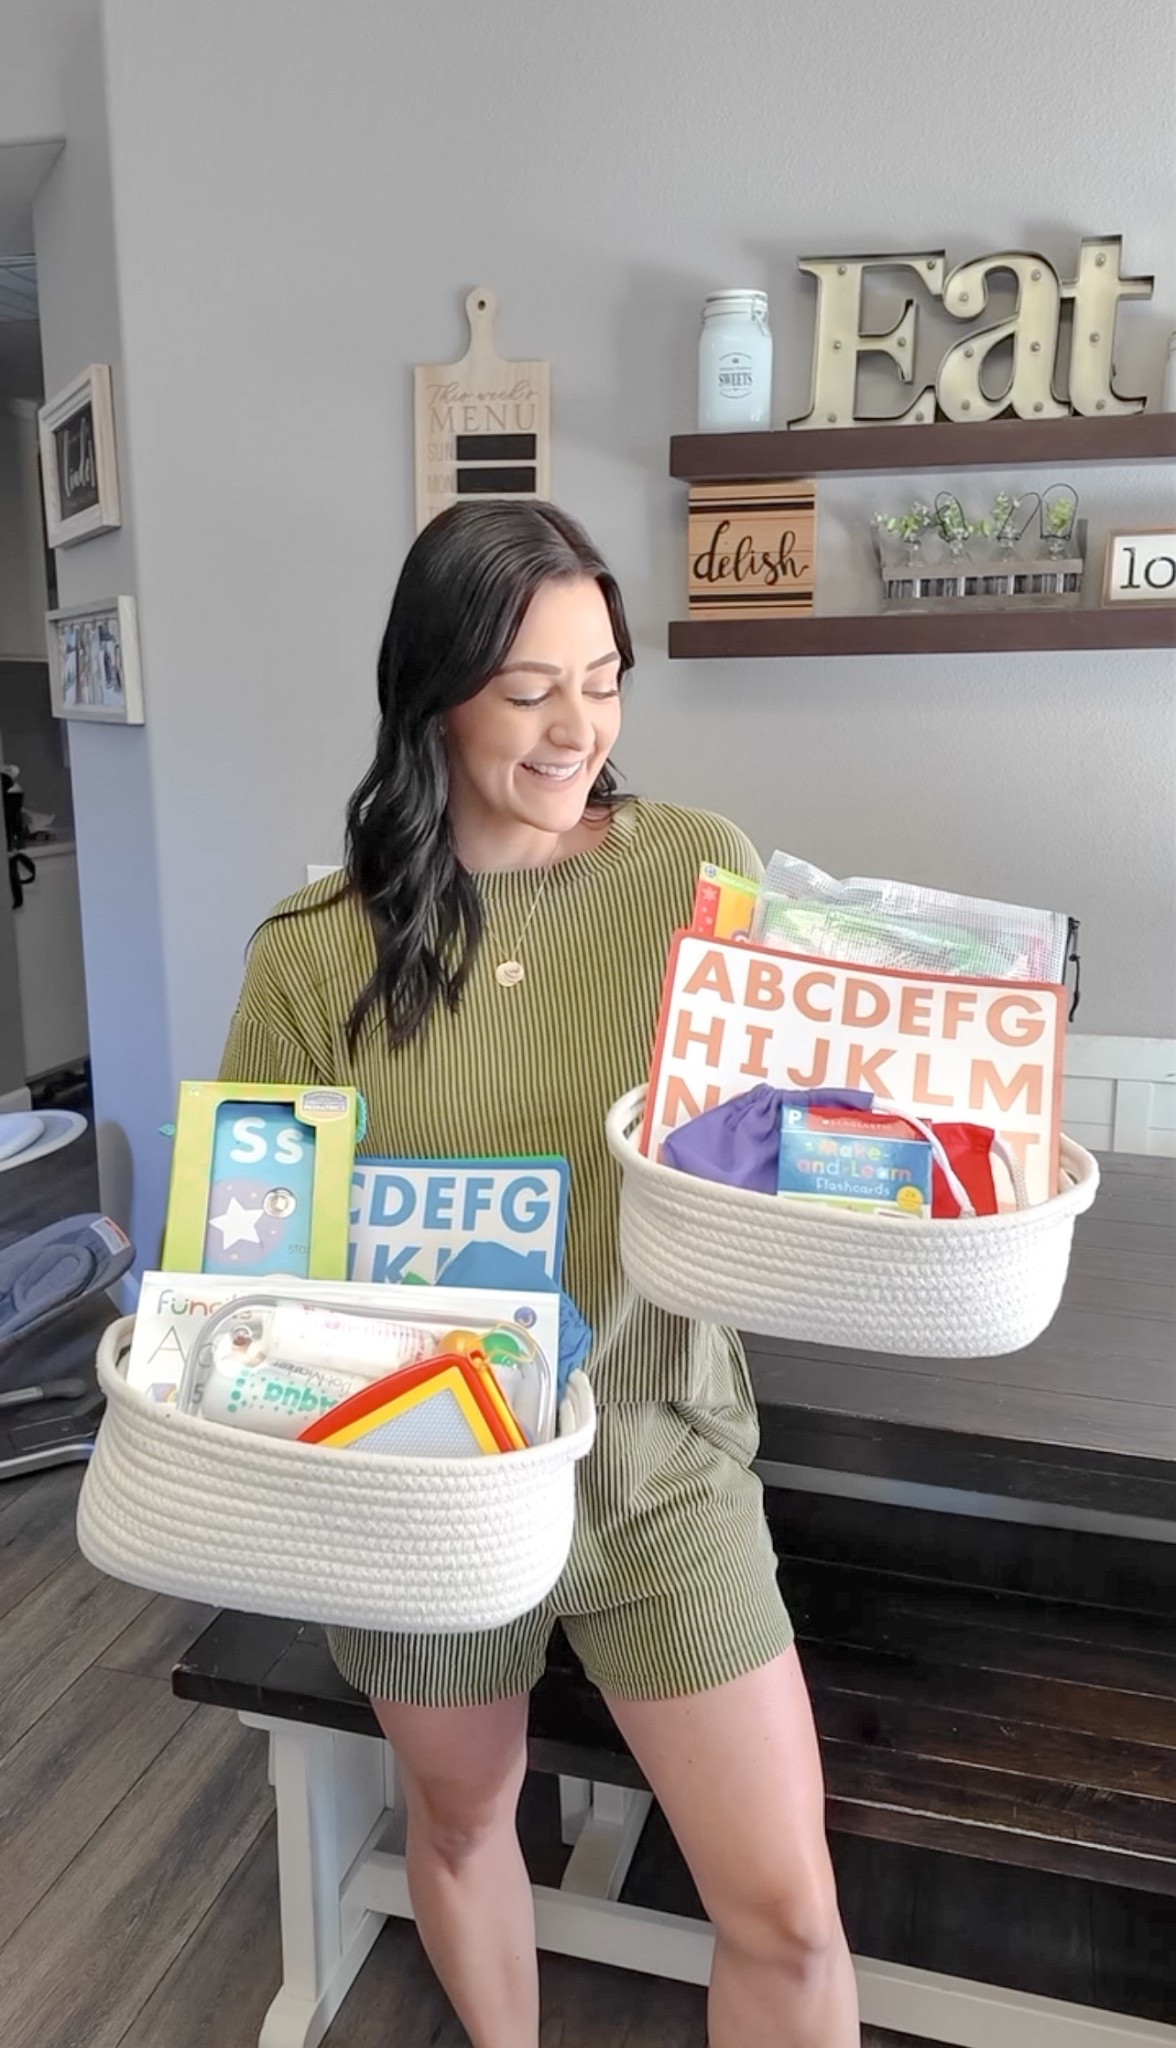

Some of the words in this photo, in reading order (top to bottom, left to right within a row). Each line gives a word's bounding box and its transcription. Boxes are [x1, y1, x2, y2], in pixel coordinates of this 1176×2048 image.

[787, 234, 1154, 432] Eat
[718, 371, 752, 387] SWEETS
[429, 403, 536, 433] MENU
[693, 519, 809, 586] delish
